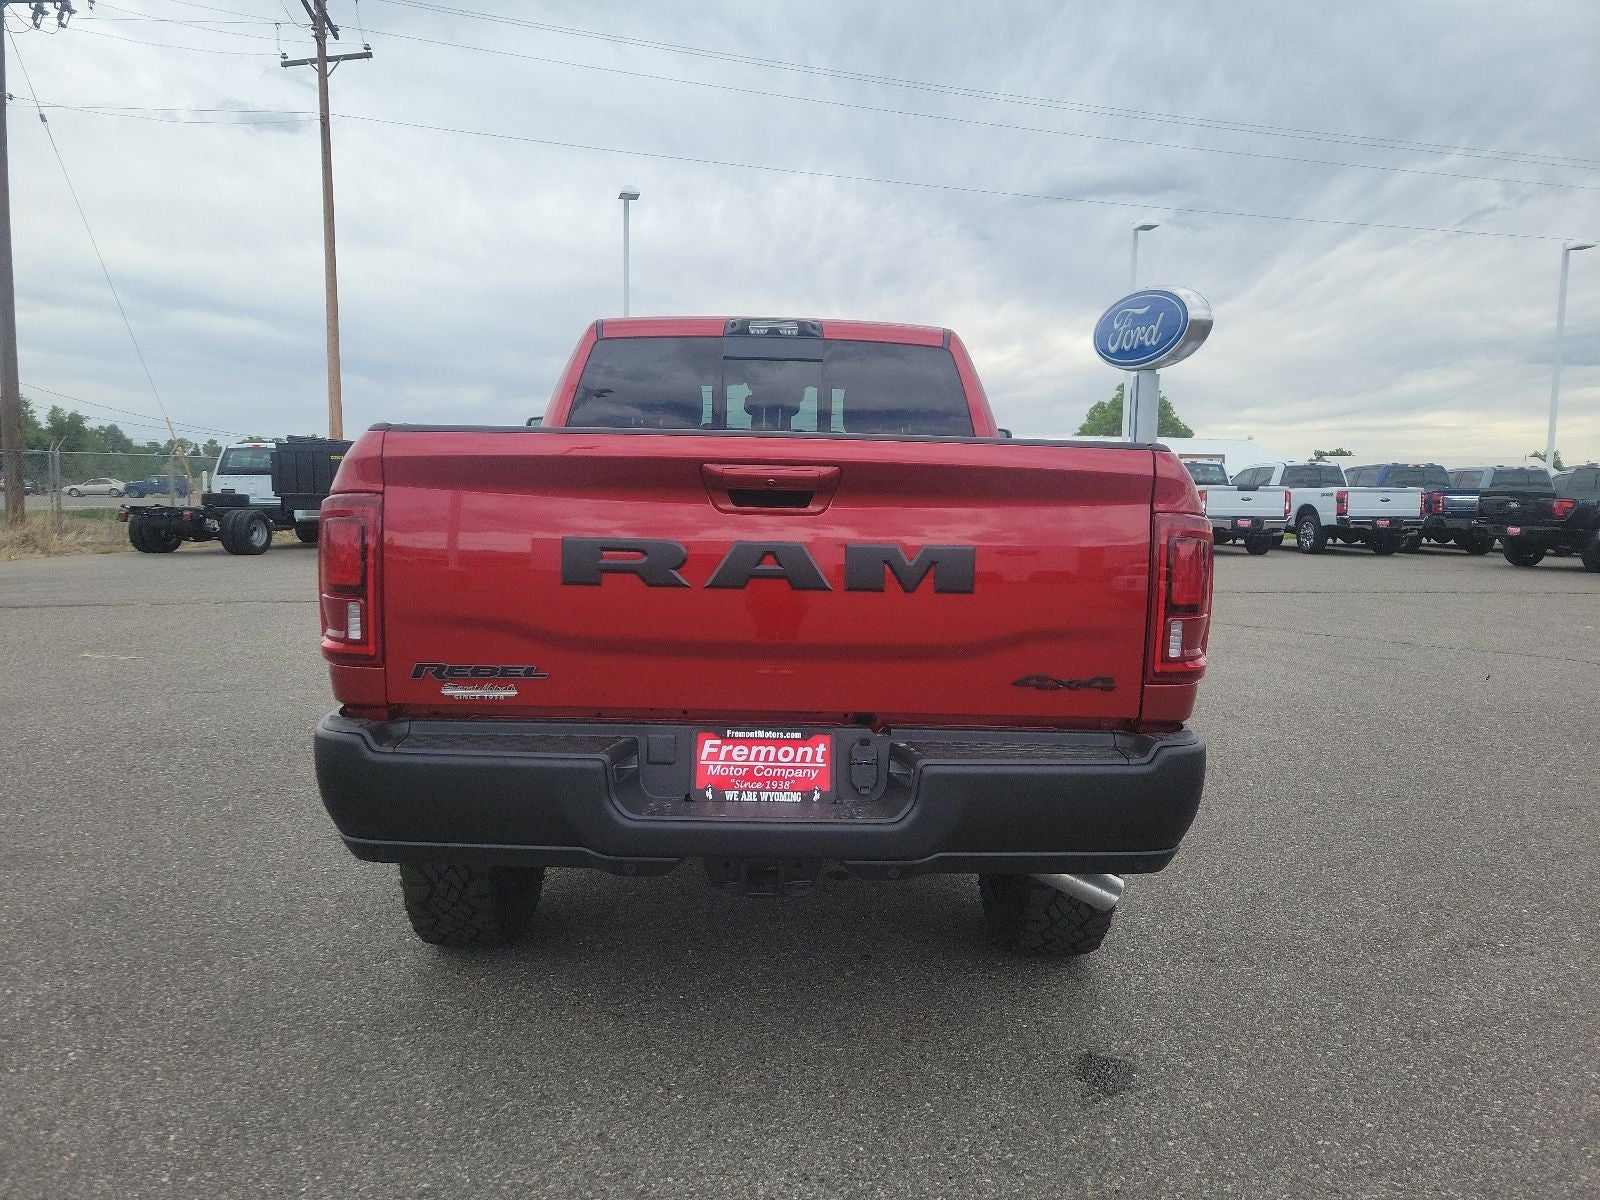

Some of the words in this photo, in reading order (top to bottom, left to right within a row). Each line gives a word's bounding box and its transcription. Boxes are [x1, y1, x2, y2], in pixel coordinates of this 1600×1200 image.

[1107, 305, 1164, 353] Ford
[561, 536, 976, 594] RAM
[410, 662, 549, 681] REBEL
[727, 729, 802, 739] FremontMotors.com
[700, 739, 826, 763] Fremont
[707, 764, 749, 776] Motor
[753, 765, 819, 780] Company
[725, 790, 739, 802] WE
[740, 791, 757, 802] ARE
[760, 791, 802, 803] WYOMING
